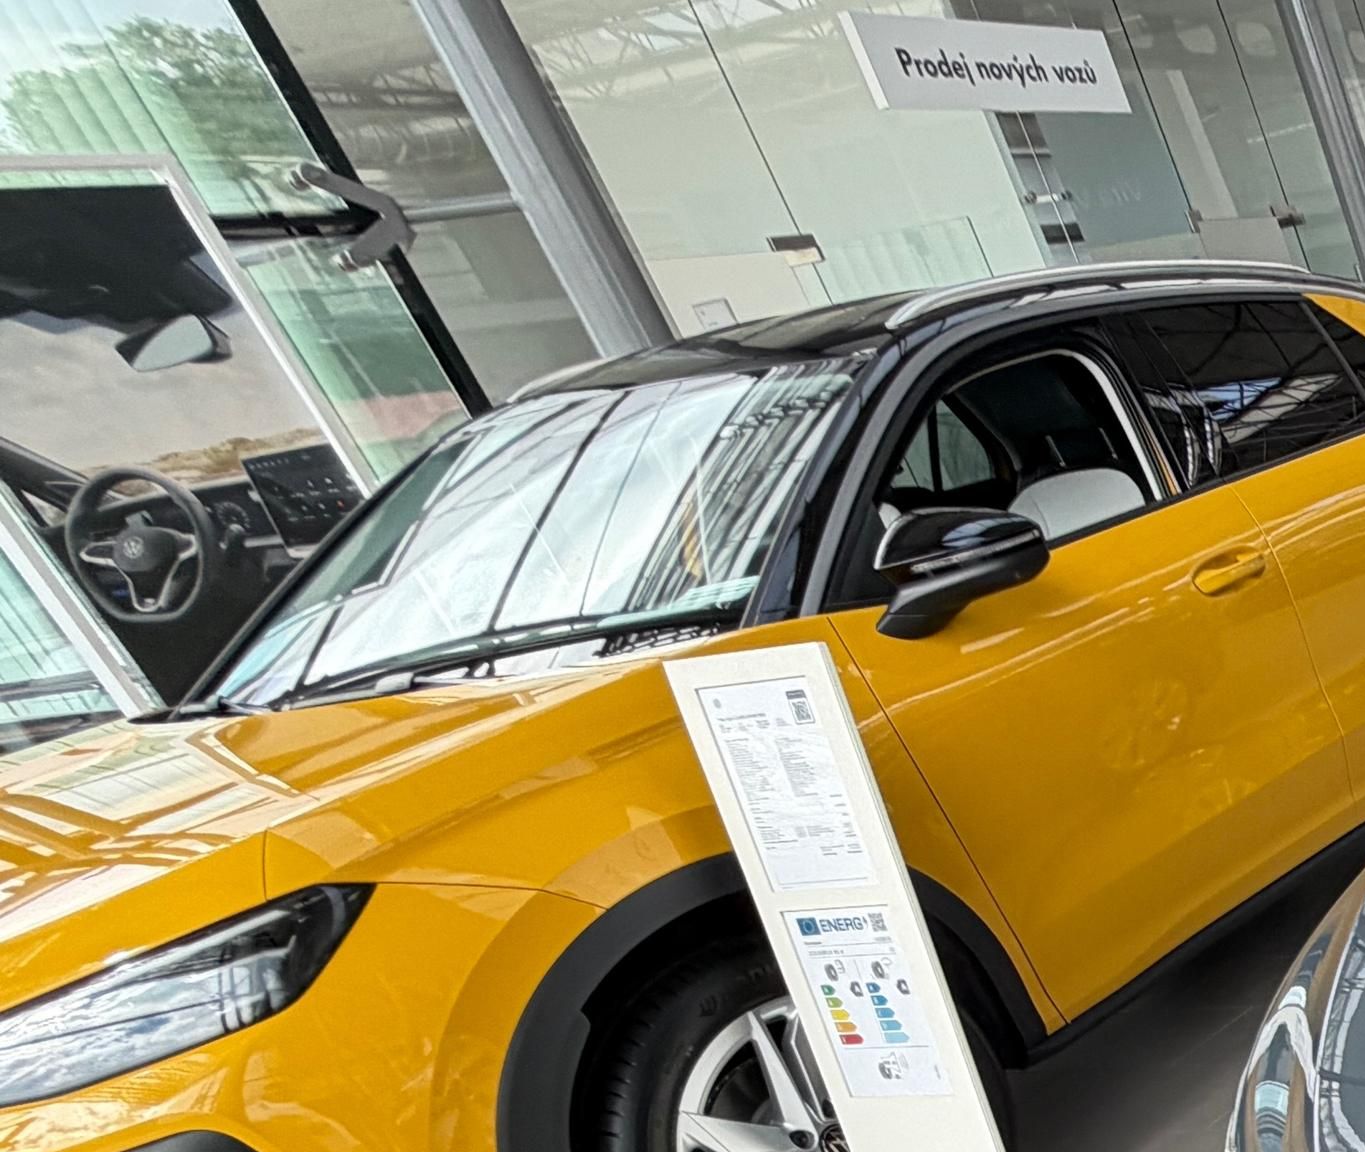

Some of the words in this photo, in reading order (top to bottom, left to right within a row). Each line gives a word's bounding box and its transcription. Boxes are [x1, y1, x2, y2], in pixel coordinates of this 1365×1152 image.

[893, 47, 976, 87] Prodej
[975, 54, 1049, 88] nových
[1051, 59, 1098, 85] vozů
[818, 916, 864, 933] ENERG
